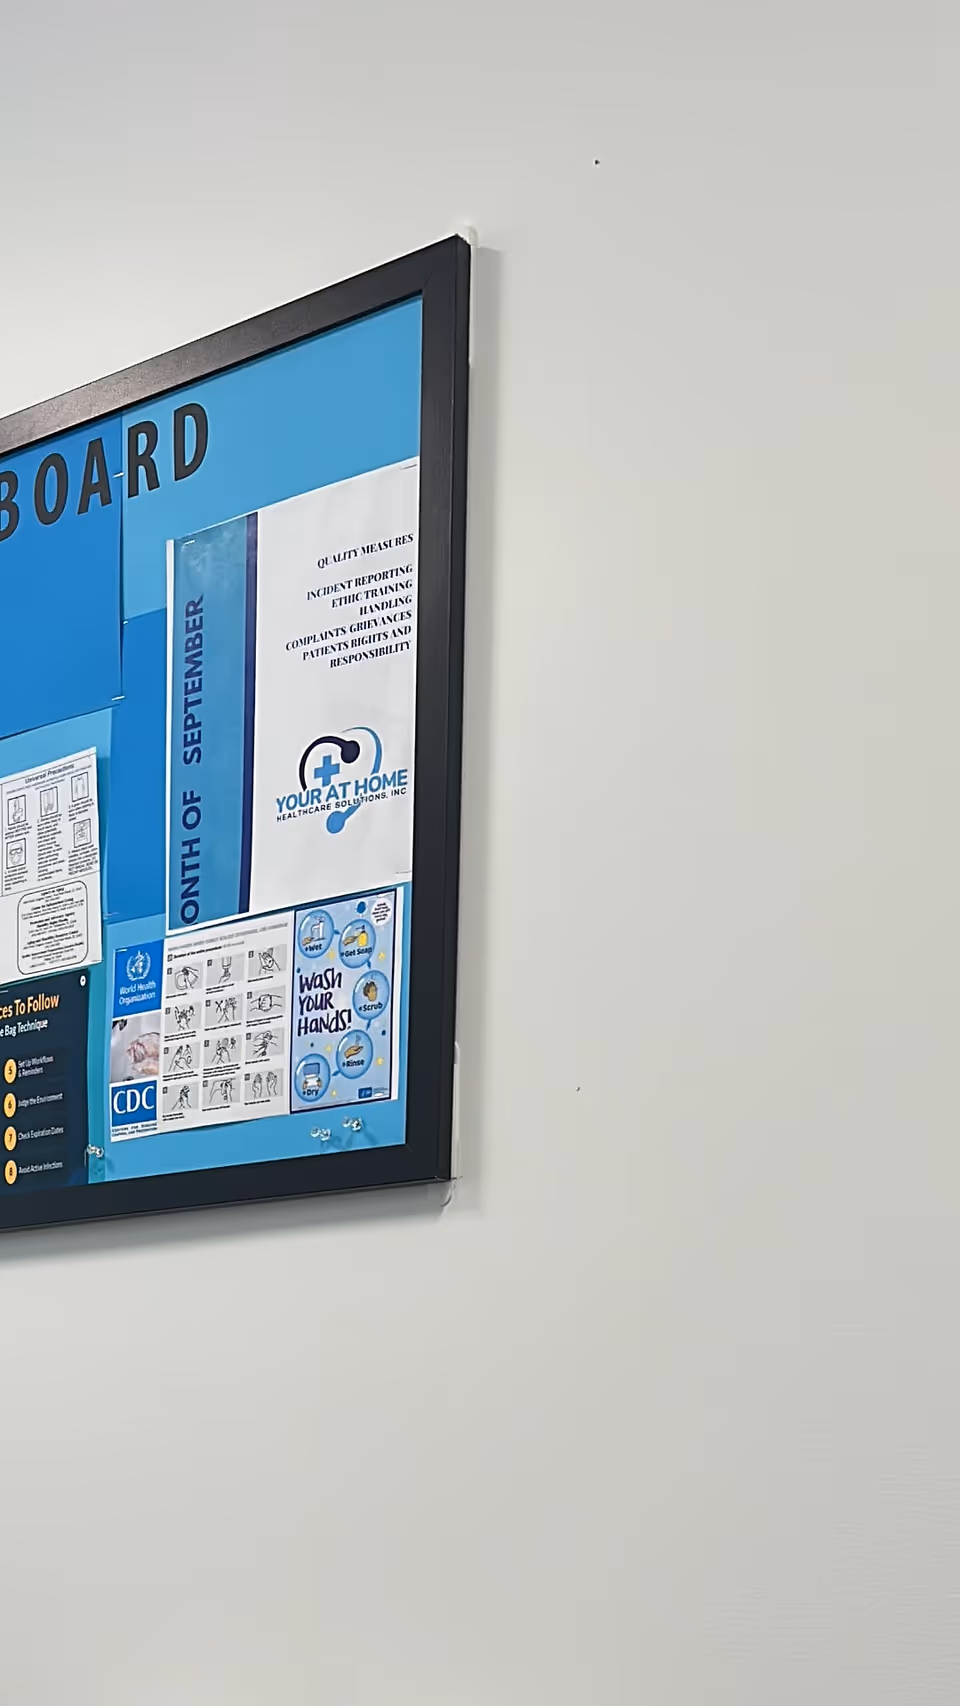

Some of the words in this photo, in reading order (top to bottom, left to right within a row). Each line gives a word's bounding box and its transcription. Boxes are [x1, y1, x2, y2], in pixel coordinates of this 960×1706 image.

[317, 548, 360, 569] QUALITY
[360, 533, 414, 556] MEASURES
[307, 580, 353, 600] INCIDENT
[354, 564, 413, 588] REPORTING
[332, 592, 362, 608] ETHIC
[363, 579, 413, 600] TRAINING
[360, 594, 412, 616] HANDLING
[286, 626, 346, 651] COMPLAINTS
[350, 610, 412, 633] GRIEVANCES
[302, 640, 349, 661] PATIENTS
[350, 631, 388, 649] RIGHTS
[390, 625, 412, 639] AND
[330, 640, 412, 668] RESPONSIBILITY
[183, 593, 204, 766] SEPTEMBER
[276, 788, 322, 813] YOUR
[326, 781, 351, 802] AT
[355, 769, 408, 796] HOME
[276, 803, 331, 822] HEALTHCARE
[391, 787, 407, 797] INC
[181, 789, 202, 831] OF
[180, 836, 201, 925] ONTH
[344, 949, 355, 958] Get
[356, 946, 373, 956] Soap
[119, 992, 155, 1006] Organization
[120, 984, 136, 995] World
[138, 980, 156, 991] Health
[14, 999, 25, 1016] To
[27, 993, 59, 1013] Follow
[363, 1002, 383, 1012] Scrub
[5, 1025, 16, 1037] Bag
[17, 1019, 48, 1033] Technique
[346, 1059, 365, 1067] Rinse
[114, 1086, 154, 1114] CDC
[307, 1089, 319, 1097] Dry
[18, 1132, 30, 1140] Check
[31, 1129, 51, 1140] Expiration
